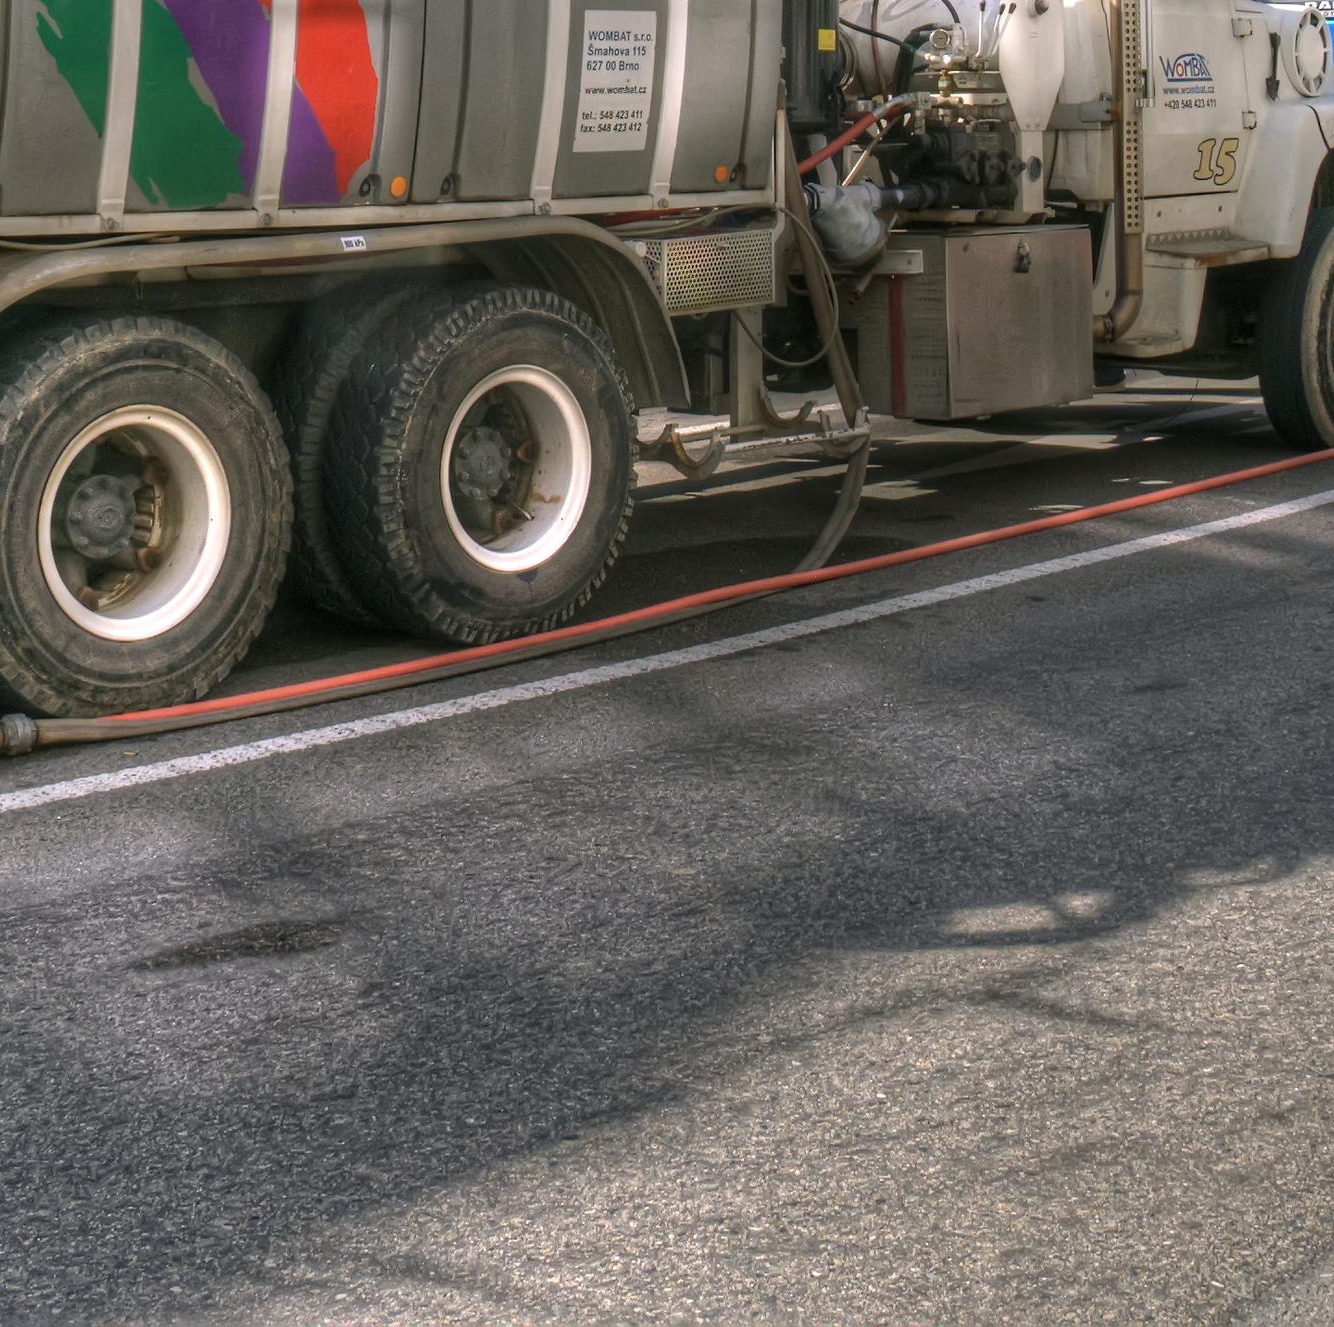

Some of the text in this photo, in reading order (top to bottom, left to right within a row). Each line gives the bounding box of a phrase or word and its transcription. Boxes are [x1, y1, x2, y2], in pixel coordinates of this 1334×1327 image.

[588, 30, 653, 42] WOMBAT s.r.o.
[587, 43, 647, 57] Šmahova 115
[586, 60, 640, 71] 627 00 Brno
[1159, 53, 1212, 77] WOMBAT
[584, 85, 647, 94] www.wombat.cz
[581, 110, 643, 120] tel.: 548 423 411
[580, 122, 642, 133] fax: 548 423 412
[1193, 137, 1239, 186] 15
